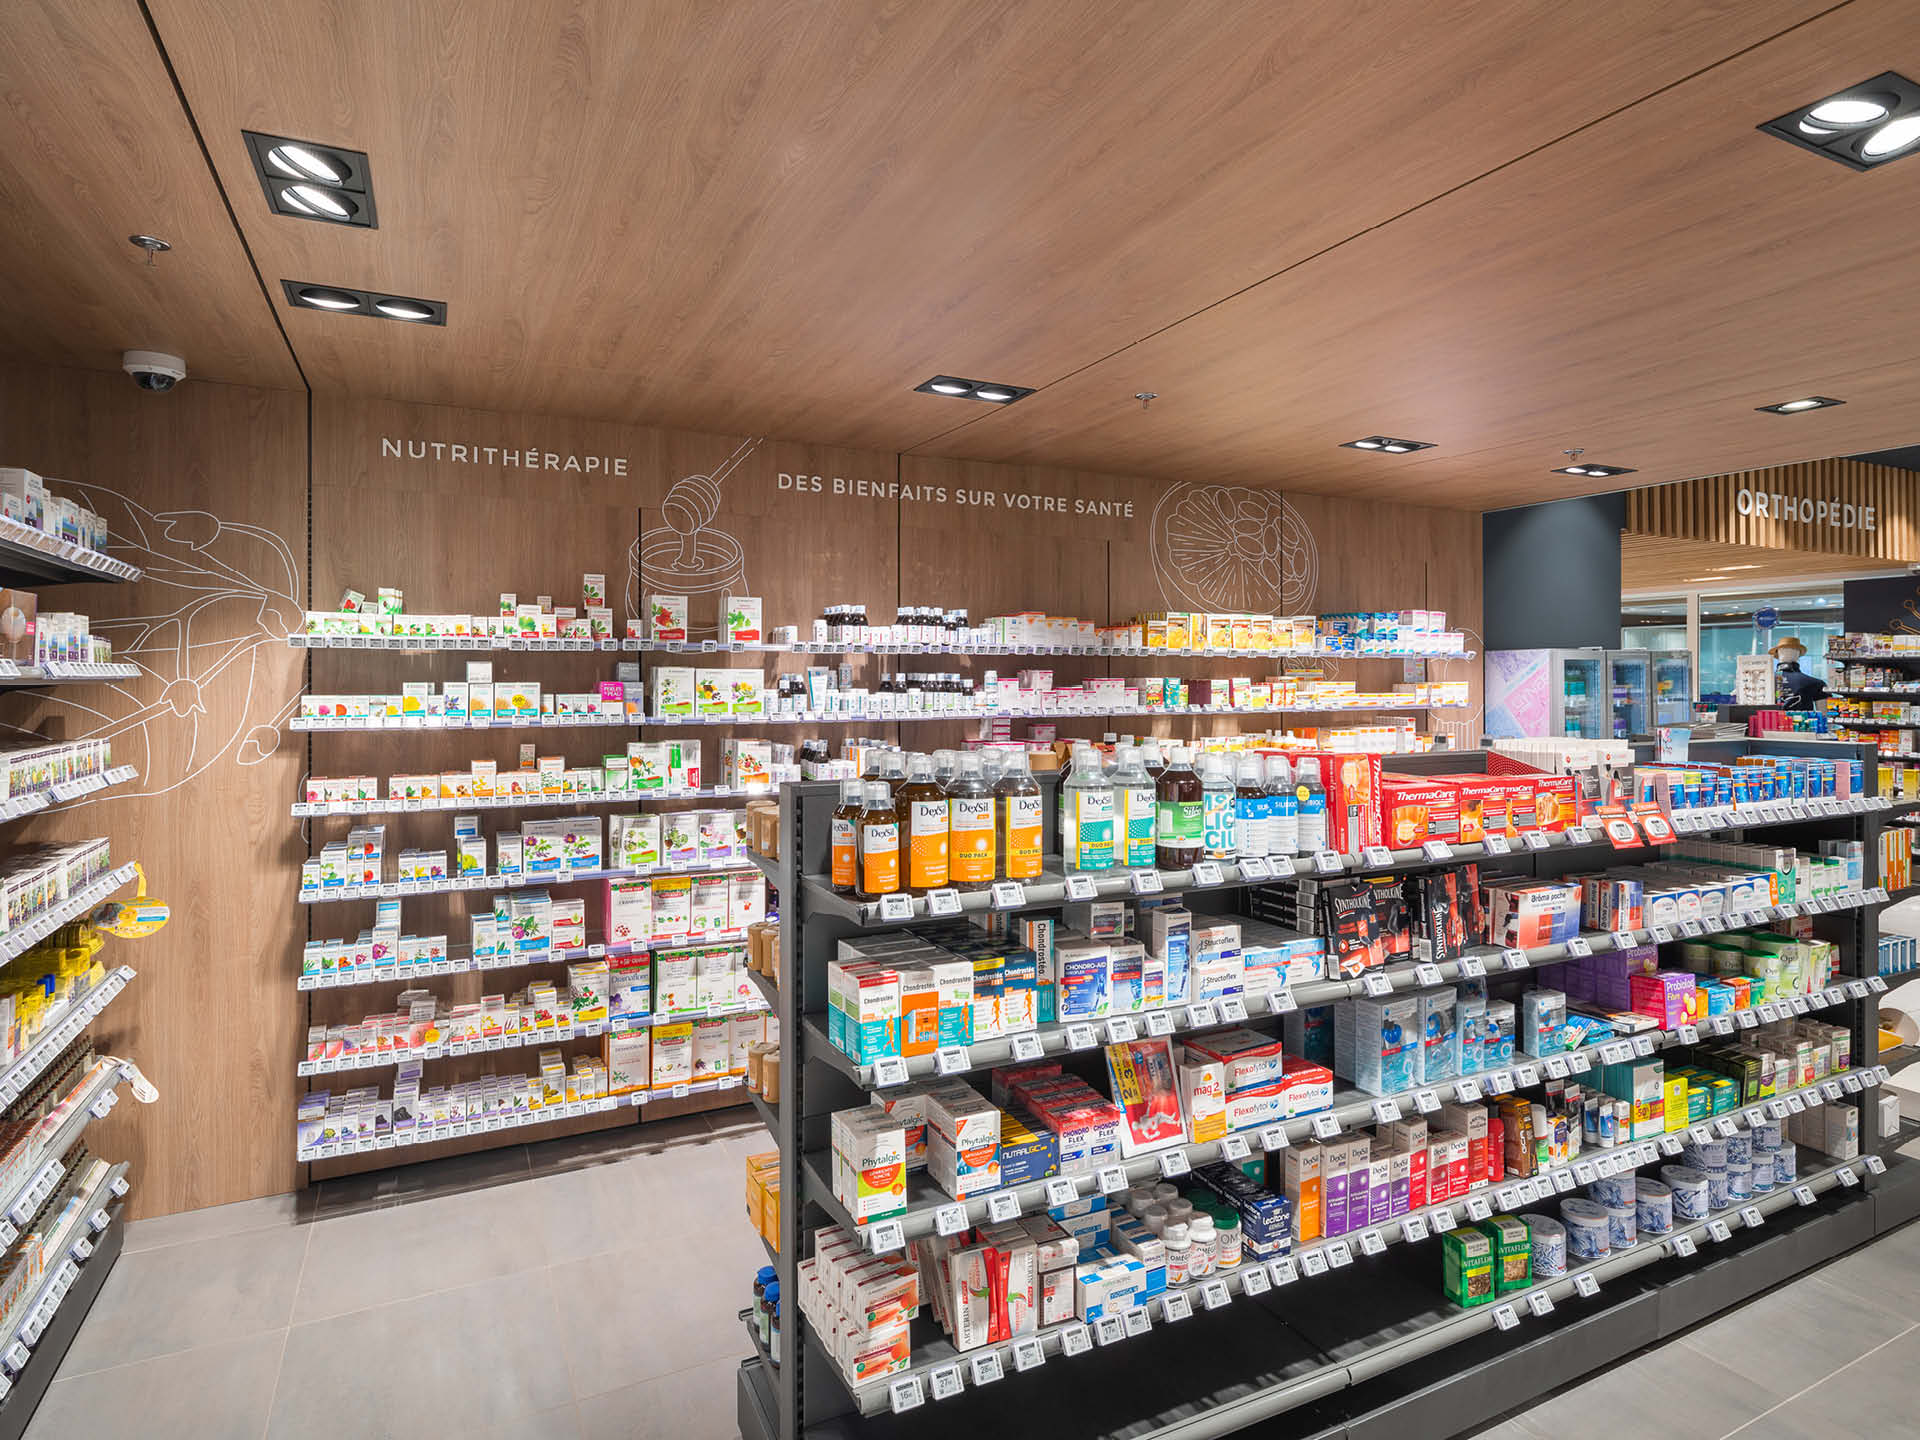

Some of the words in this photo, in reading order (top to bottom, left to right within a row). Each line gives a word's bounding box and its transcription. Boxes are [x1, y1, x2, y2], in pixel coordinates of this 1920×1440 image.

[381, 437, 628, 476] NUTRITHÉRAPIE
[777, 472, 823, 493] DES
[832, 477, 948, 503] BIENFAITS
[955, 488, 996, 507] SUR
[1003, 492, 1068, 513] VOTRE
[1074, 499, 1135, 518] SANTÉ
[1736, 487, 1877, 532] ORTHOPÉDIE
[1538, 778, 1573, 788] ThermaCare
[1397, 789, 1457, 801] ThermaCare
[1462, 786, 1505, 796] ThermaCare
[1372, 759, 1382, 846] ThermaCare
[1193, 1085, 1212, 1096] mag
[1213, 1082, 1220, 1092] 2
[1233, 1104, 1268, 1117] Flexofytol
[1063, 1126, 1090, 1138] CHONDRO
[1068, 1135, 1084, 1143] FLEX
[862, 1151, 900, 1168] Phytalgic
